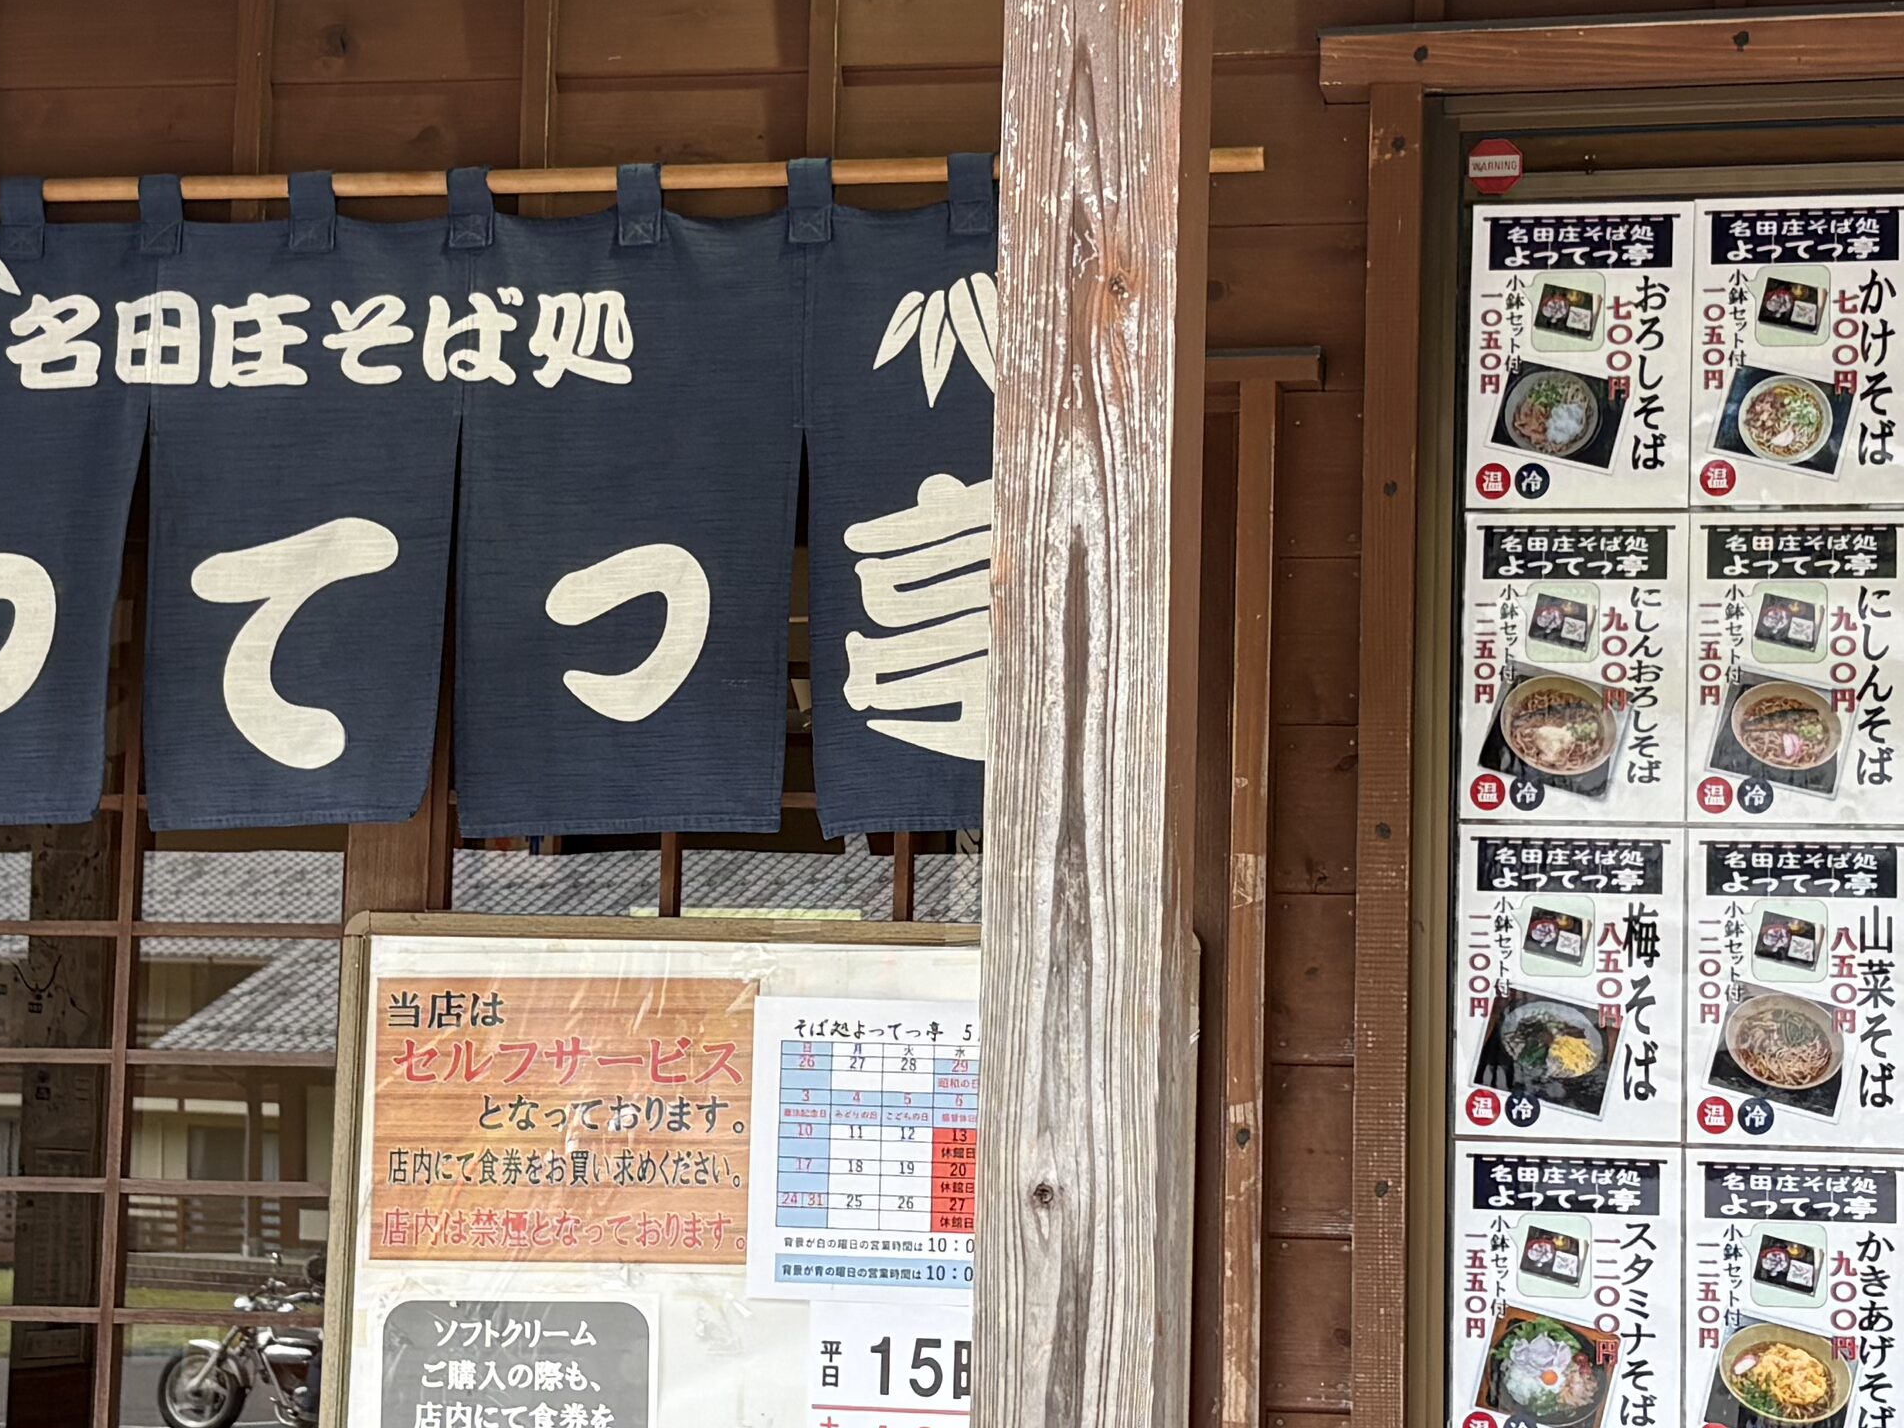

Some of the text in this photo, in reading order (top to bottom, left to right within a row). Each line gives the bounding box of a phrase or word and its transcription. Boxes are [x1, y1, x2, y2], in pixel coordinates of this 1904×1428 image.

[1472, 161, 1517, 171] WARNING
[1507, 226, 1654, 243] 名田庄そば処
[7, 290, 634, 388] 名田庄そば処
[1505, 276, 1525, 374] 小鉢セット付
[1631, 276, 1669, 470] おろしそば
[1858, 269, 1897, 465] かけそば
[1725, 535, 1877, 552] 名田庄そば処
[1725, 585, 1744, 683] 小鉢セット付
[1627, 586, 1663, 783] にしんおろしそば
[1856, 586, 1894, 785] にしんそば
[1724, 853, 1878, 871] 名田庄そば処
[1494, 897, 1515, 998] 小鉢セット付
[387, 992, 505, 1027] 当店は
[1622, 902, 1660, 1101] 梅そば
[1856, 905, 1895, 1108] 山菜そば
[393, 1039, 744, 1085] セルフサービス
[479, 1095, 746, 1134] となっております。
[388, 1149, 741, 1188] 店内にて食券をお買い求めください。
[1490, 1165, 1641, 1186] 名田庄そば処
[381, 1209, 746, 1247] 店内は禁煙となっております。
[1723, 1224, 1743, 1328] 小鉢セット付
[434, 1319, 596, 1346] ソフトクリーム
[1621, 1223, 1657, 1426] スタミナそば
[421, 1362, 601, 1390] ご購入の際も、
[820, 1341, 842, 1388] 平日
